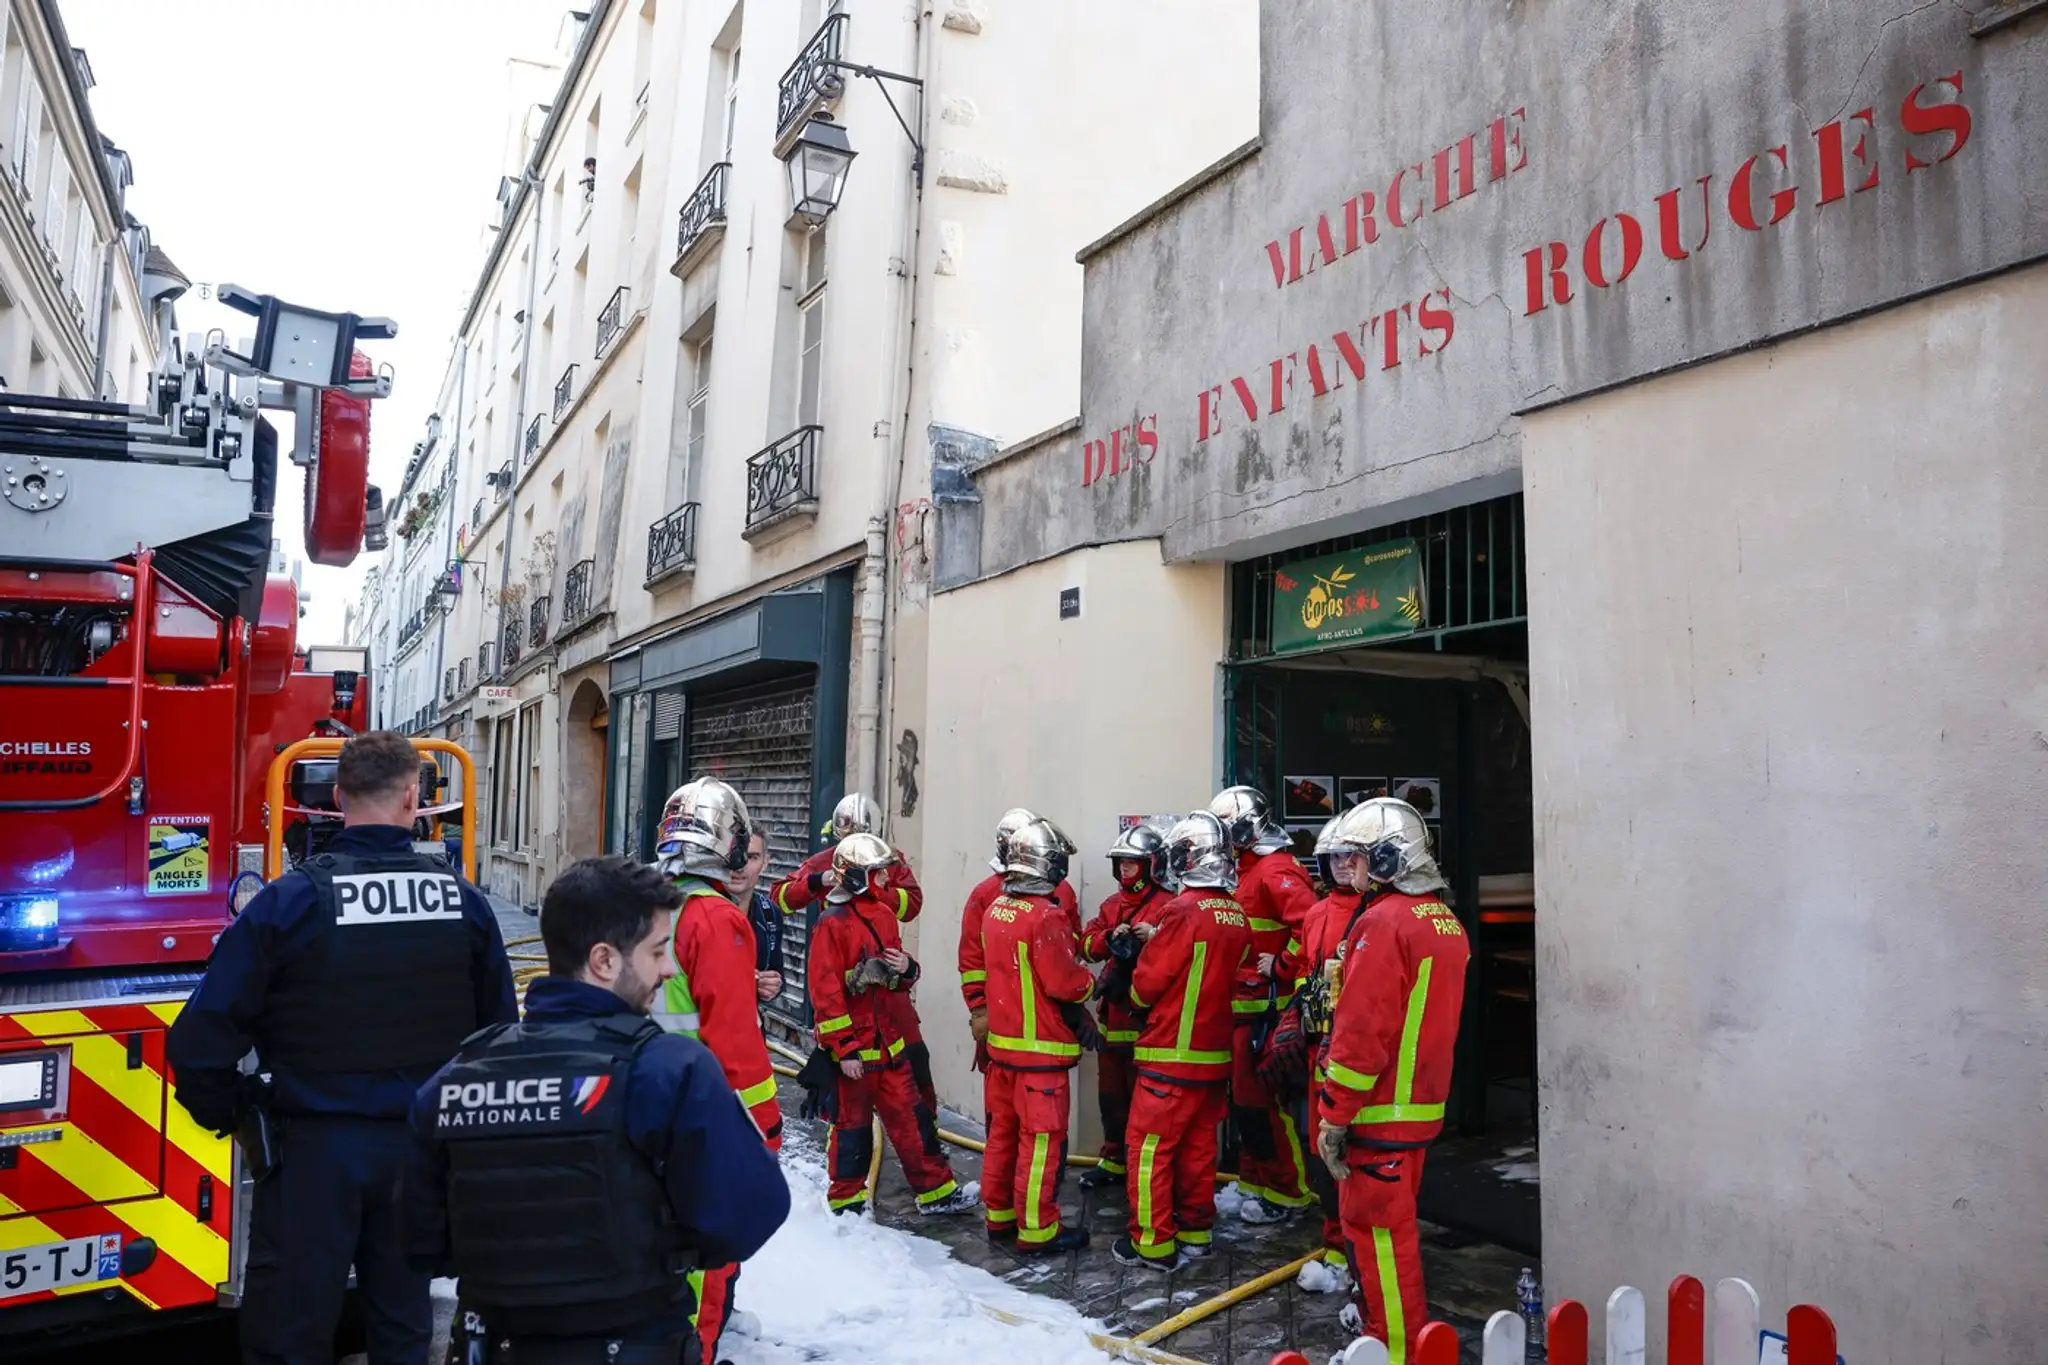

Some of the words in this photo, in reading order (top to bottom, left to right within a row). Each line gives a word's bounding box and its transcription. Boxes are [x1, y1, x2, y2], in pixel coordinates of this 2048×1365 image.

[1265, 106, 1528, 289] MARCHE
[1082, 413, 1158, 488] DES
[1196, 286, 1455, 443] ENFANTS
[1522, 70, 1972, 317] ROUGES
[150, 816, 211, 825] ATTENTION
[155, 870, 203, 881] ANGLES
[157, 880, 200, 889] MORTS
[333, 879, 462, 917] POLICE
[990, 906, 1017, 923] PARIS
[1214, 911, 1245, 927] PARIS
[440, 1077, 562, 1109] POLICE
[438, 1106, 561, 1127] NATIONALE
[100, 1255, 120, 1273] 75
